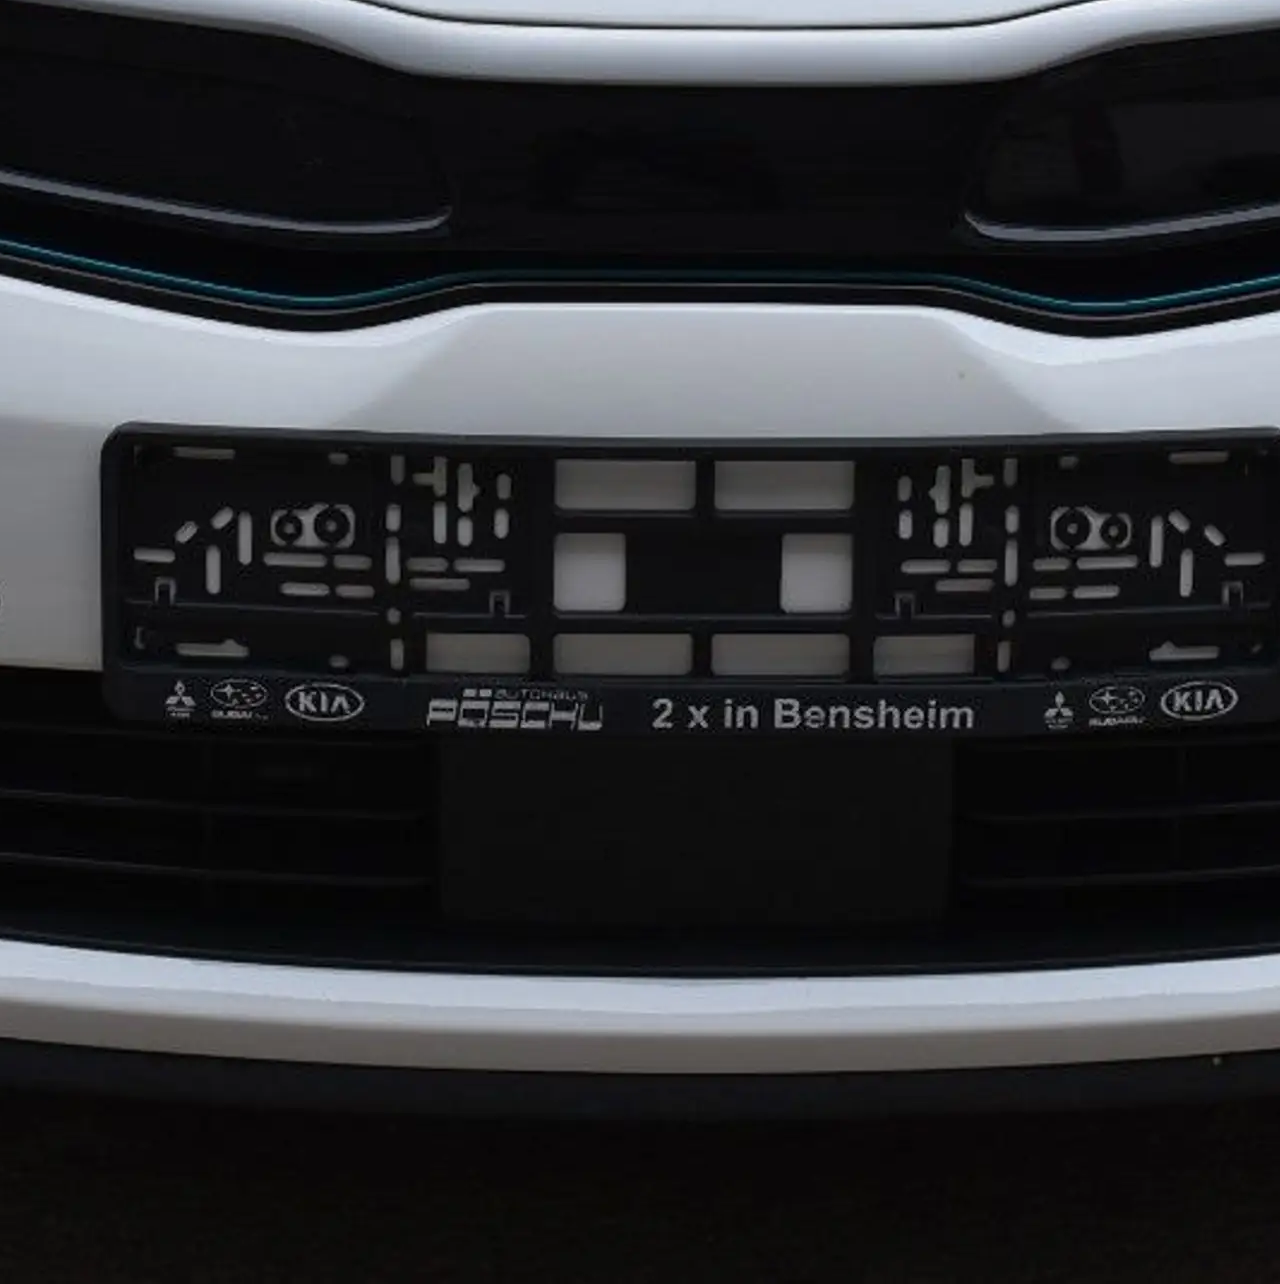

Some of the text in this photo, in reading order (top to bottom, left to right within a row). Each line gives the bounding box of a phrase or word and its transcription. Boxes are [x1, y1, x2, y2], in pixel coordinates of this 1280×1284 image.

[297, 690, 350, 714] KIA
[1172, 688, 1225, 712] KIA
[652, 697, 975, 730] 2 x in Bensheim
